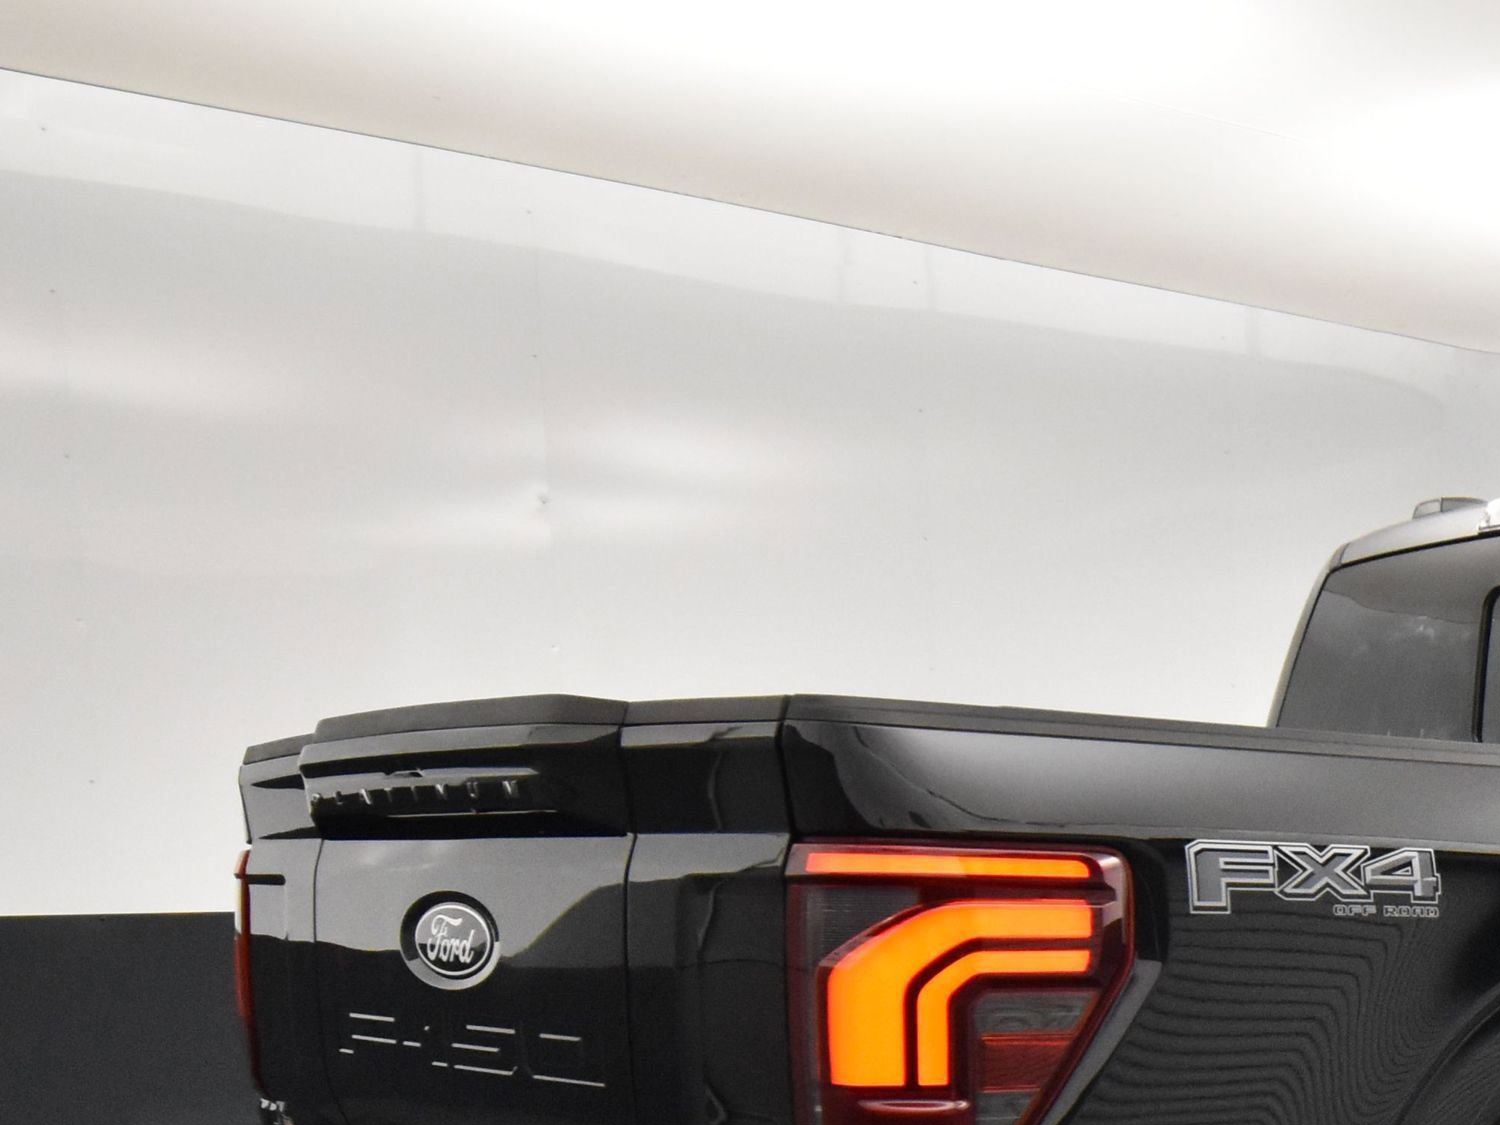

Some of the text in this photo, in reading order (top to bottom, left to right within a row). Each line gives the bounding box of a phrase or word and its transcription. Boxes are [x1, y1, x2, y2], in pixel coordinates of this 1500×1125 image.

[1185, 838, 1441, 914] FX4
[1332, 903, 1440, 918] OFF ROAD
[426, 912, 475, 964] Ford
